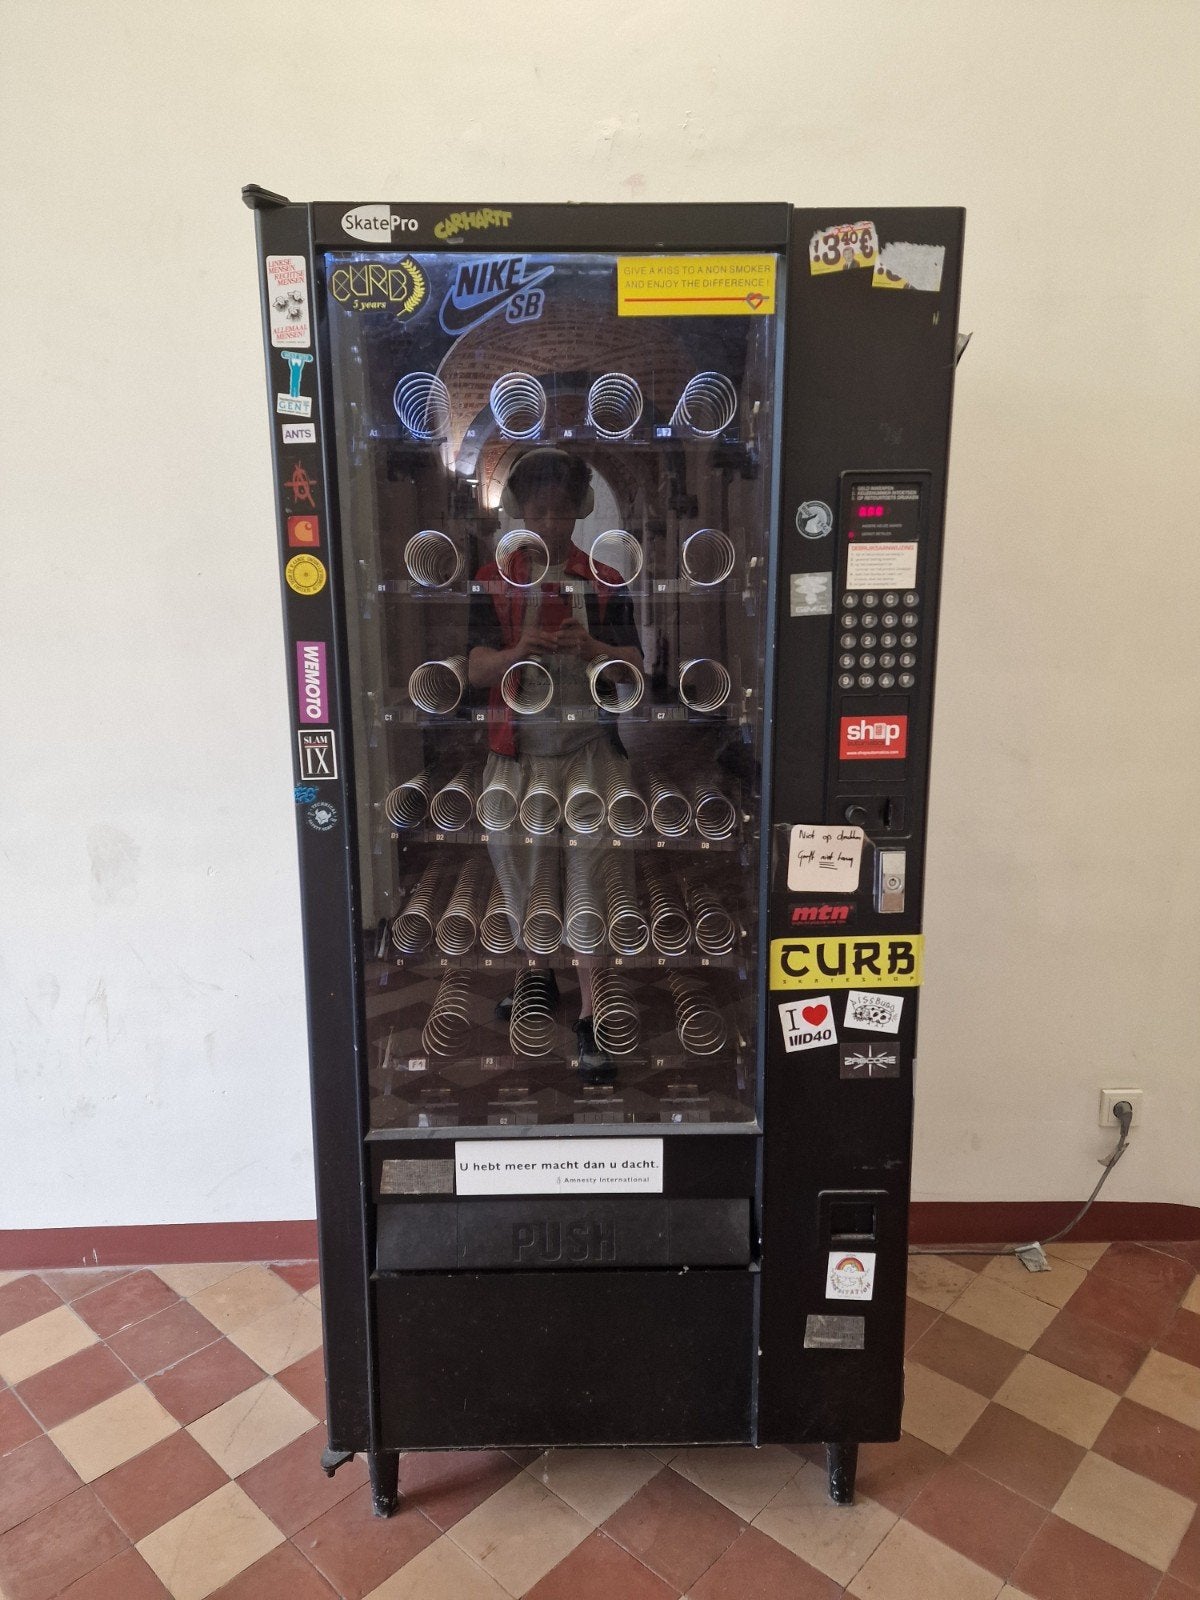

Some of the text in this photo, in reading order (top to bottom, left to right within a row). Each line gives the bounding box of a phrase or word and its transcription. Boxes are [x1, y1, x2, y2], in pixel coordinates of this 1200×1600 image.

[345, 214, 419, 232] SkatePro
[434, 208, 512, 239] CARHARTT
[624, 264, 771, 275] GIVE A KISS TO A NON SMOKER
[332, 265, 407, 301] CURB
[456, 257, 523, 297] NIKE
[626, 280, 645, 289] AND
[646, 280, 679, 288] ENJOY
[682, 279, 700, 288] THE
[702, 278, 763, 288] DIFFERENCE
[352, 300, 387, 312] 5 years
[509, 292, 541, 319] SB
[278, 400, 310, 412] GENT
[285, 429, 312, 439] ANTS
[846, 594, 914, 604] A B C D
[846, 616, 913, 625] E F G H
[846, 636, 850, 645] 1
[865, 636, 871, 645] 2
[885, 636, 891, 645] 3
[844, 656, 910, 665] 5 6 7 8
[303, 646, 322, 720] WEMOTO
[843, 676, 871, 685] 9 10
[304, 736, 328, 745] SLAM
[306, 747, 331, 775] IX
[792, 904, 849, 921] mtn
[780, 942, 915, 977] CURB
[786, 1008, 800, 1032] I
[460, 1163, 469, 1171] U
[473, 1162, 501, 1171] hebt
[541, 1161, 579, 1170] macht
[583, 1160, 605, 1169] dan
[622, 1160, 660, 1169] dacht.
[512, 1221, 616, 1262] PUSH
